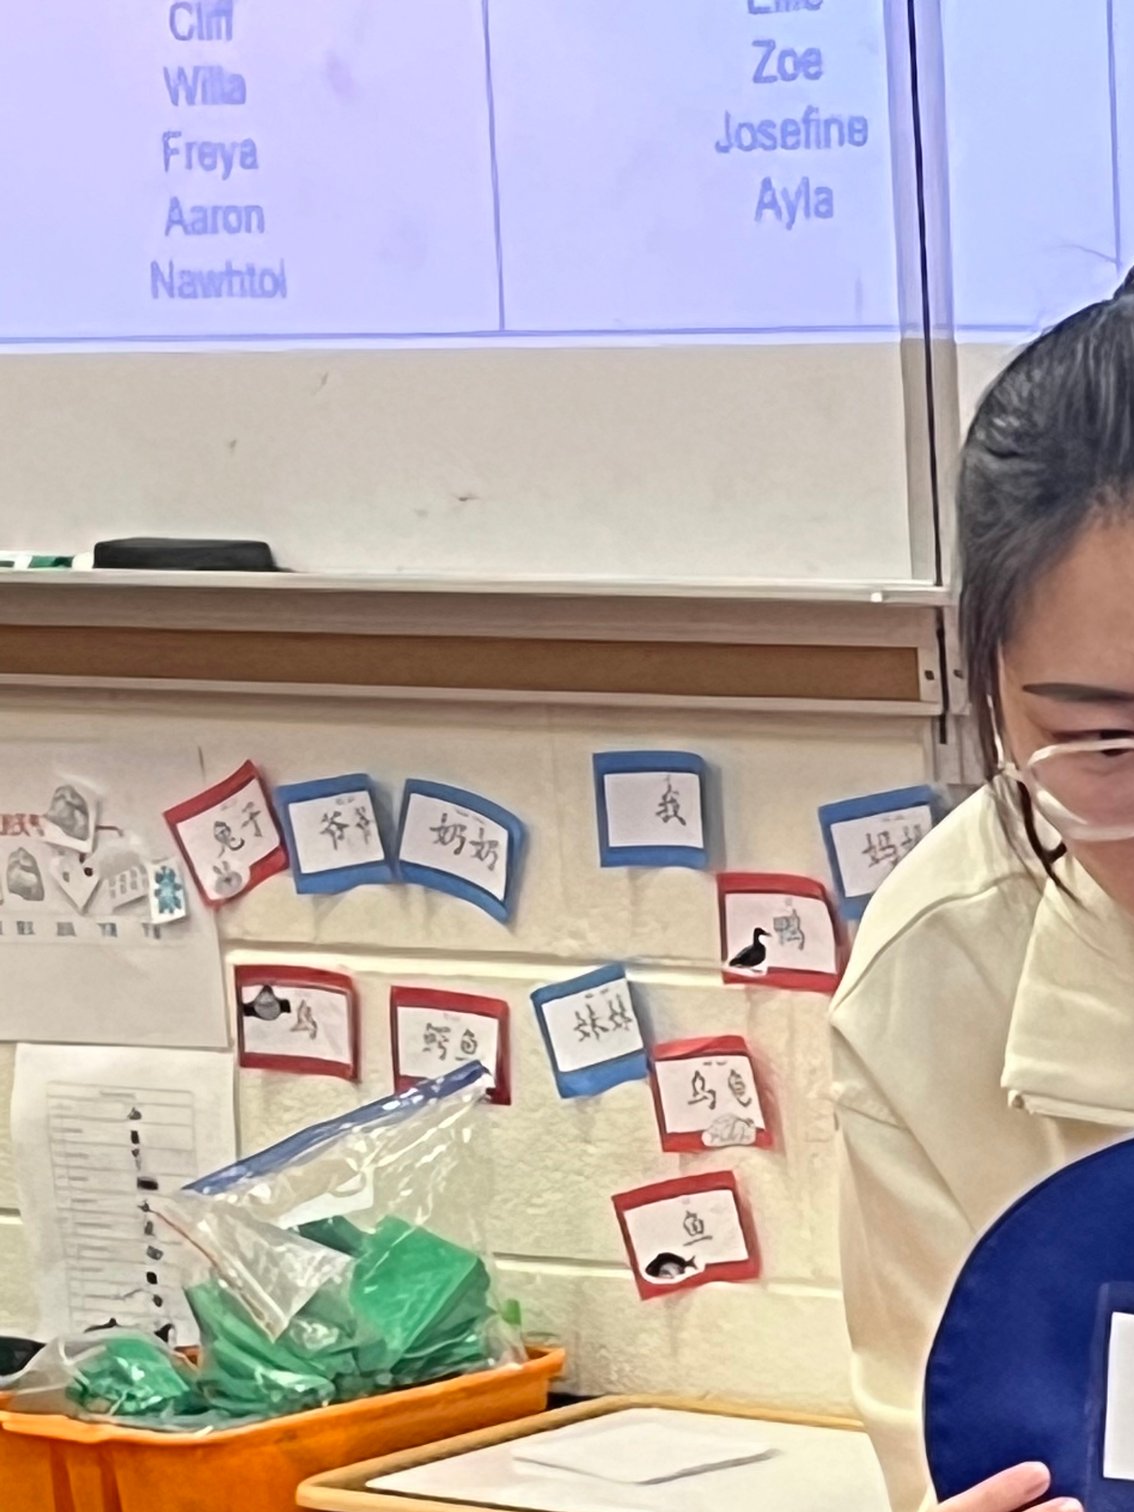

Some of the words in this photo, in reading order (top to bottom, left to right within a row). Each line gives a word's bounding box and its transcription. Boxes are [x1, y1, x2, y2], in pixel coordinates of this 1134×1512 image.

[751, 39, 823, 83] Zoe
[715, 105, 868, 153] Josefine
[162, 130, 259, 181] Freya
[164, 196, 265, 237] Aaron
[754, 176, 834, 231] Ayla
